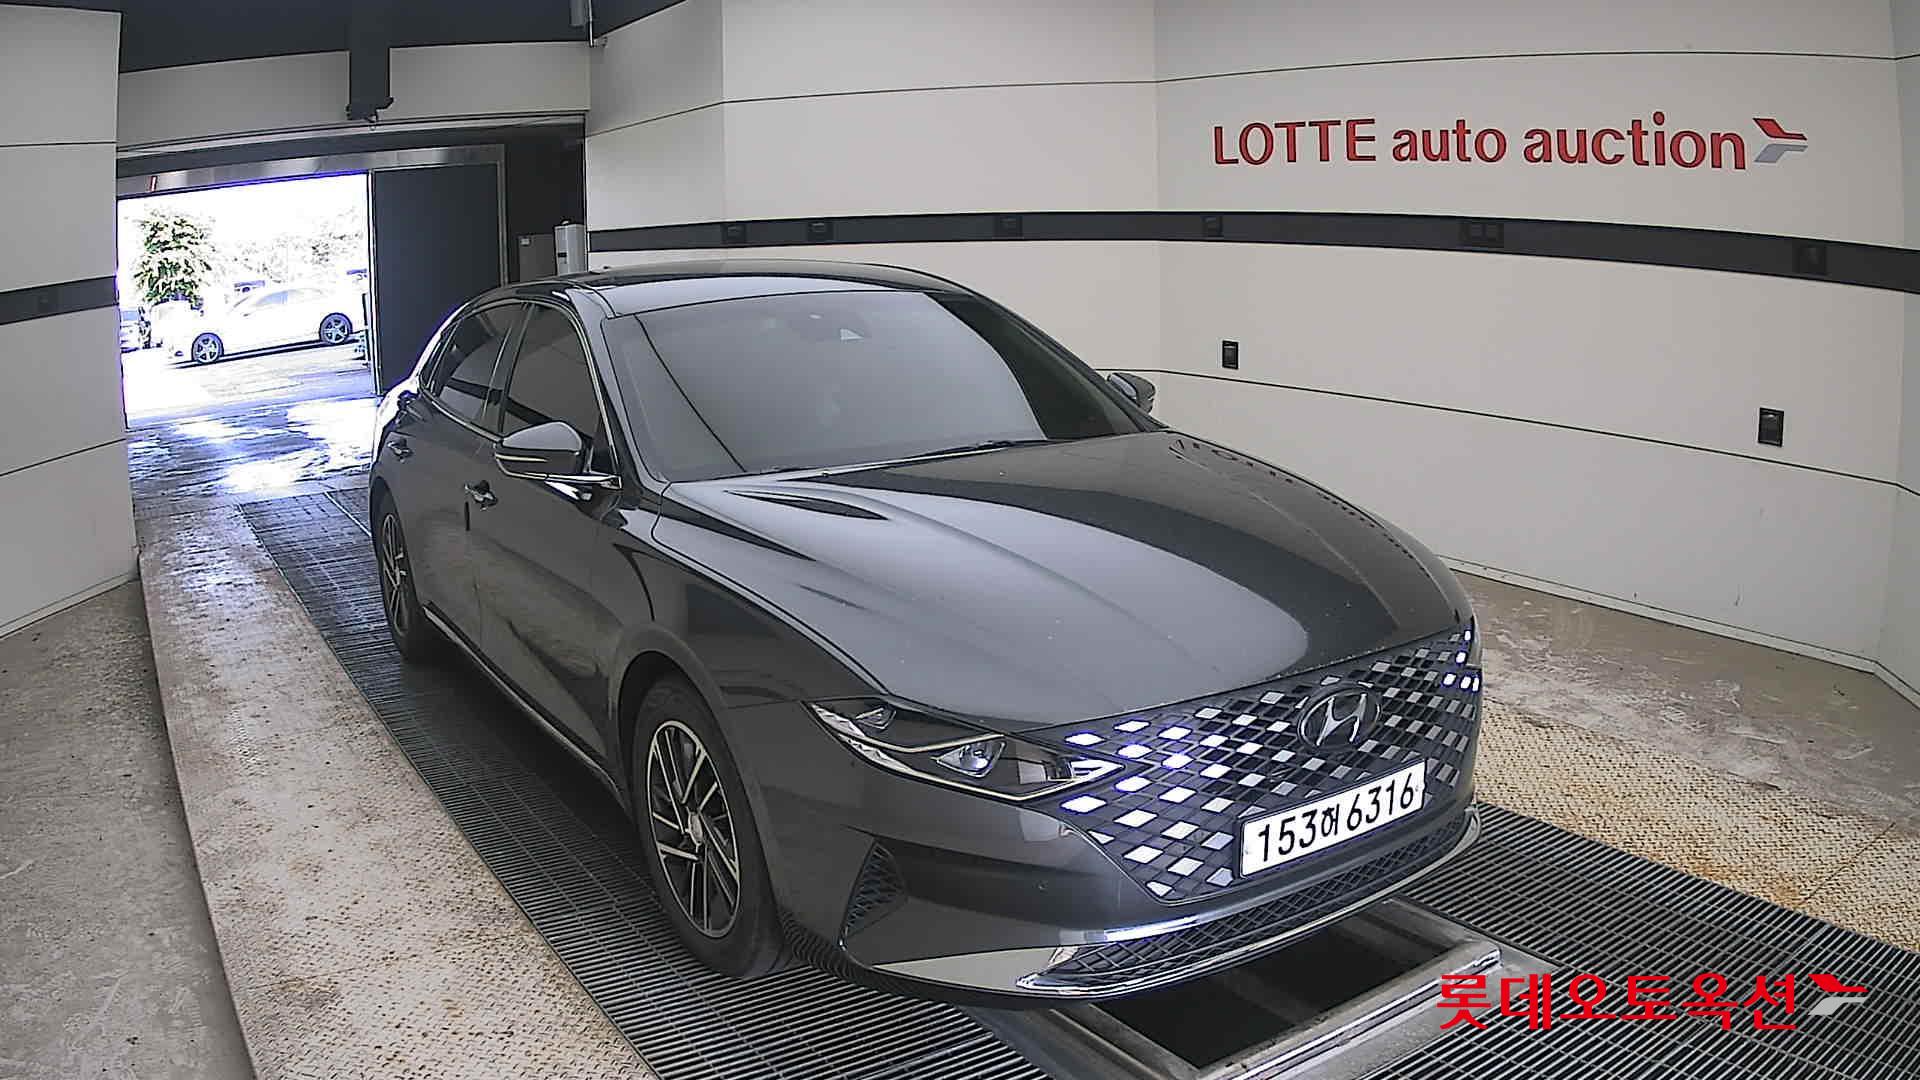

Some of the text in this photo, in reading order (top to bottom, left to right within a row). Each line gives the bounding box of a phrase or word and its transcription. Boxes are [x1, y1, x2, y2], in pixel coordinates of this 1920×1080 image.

[1213, 110, 1747, 170] LOTTE auto auction
